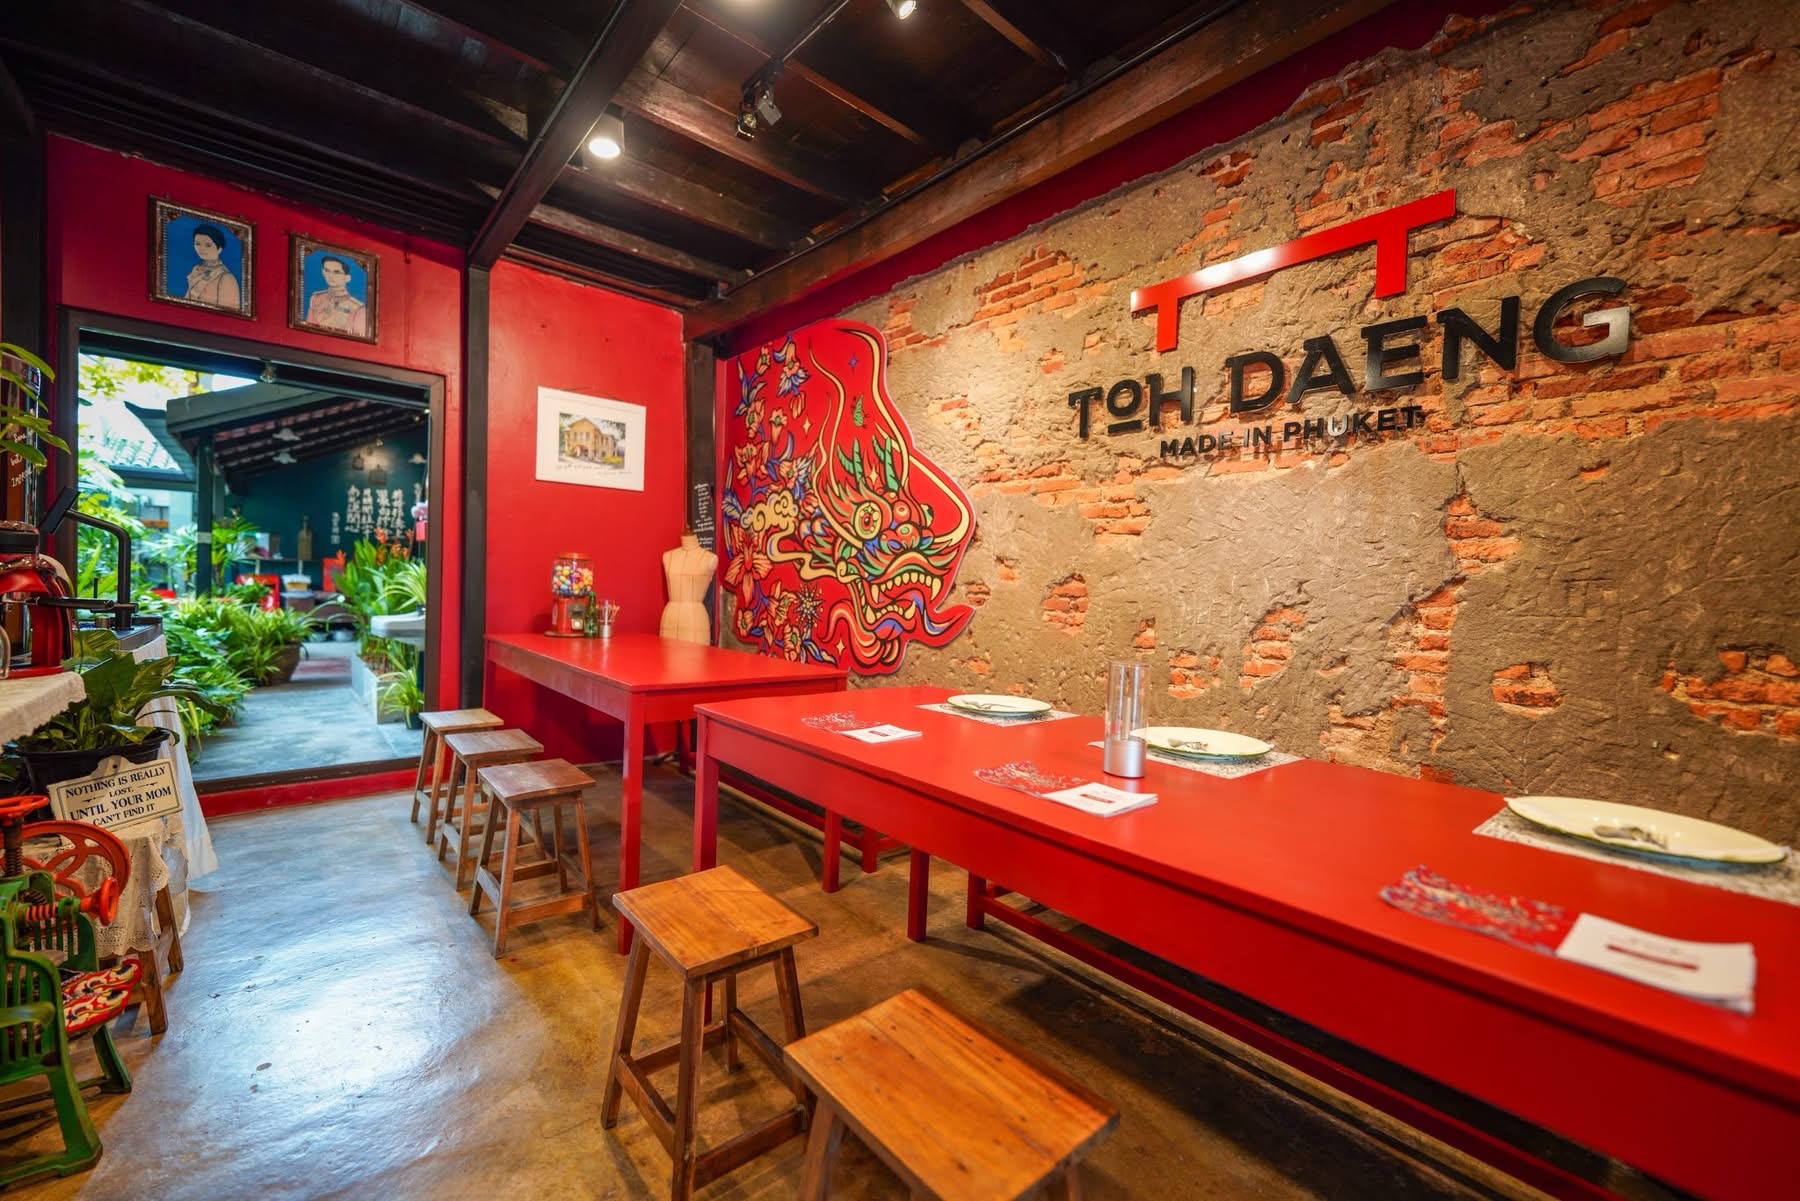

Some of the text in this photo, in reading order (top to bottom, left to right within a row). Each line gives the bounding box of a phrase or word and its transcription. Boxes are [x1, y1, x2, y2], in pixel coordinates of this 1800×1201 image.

[1068, 277, 1632, 439] TOH DAENG
[1160, 405, 1422, 458] MADE IN PHUKET
[65, 766, 166, 798] NOTHING IS REALLY
[70, 786, 172, 821] UNTIL YOUR MOM
[93, 803, 156, 827] CAN'T FIND IT
